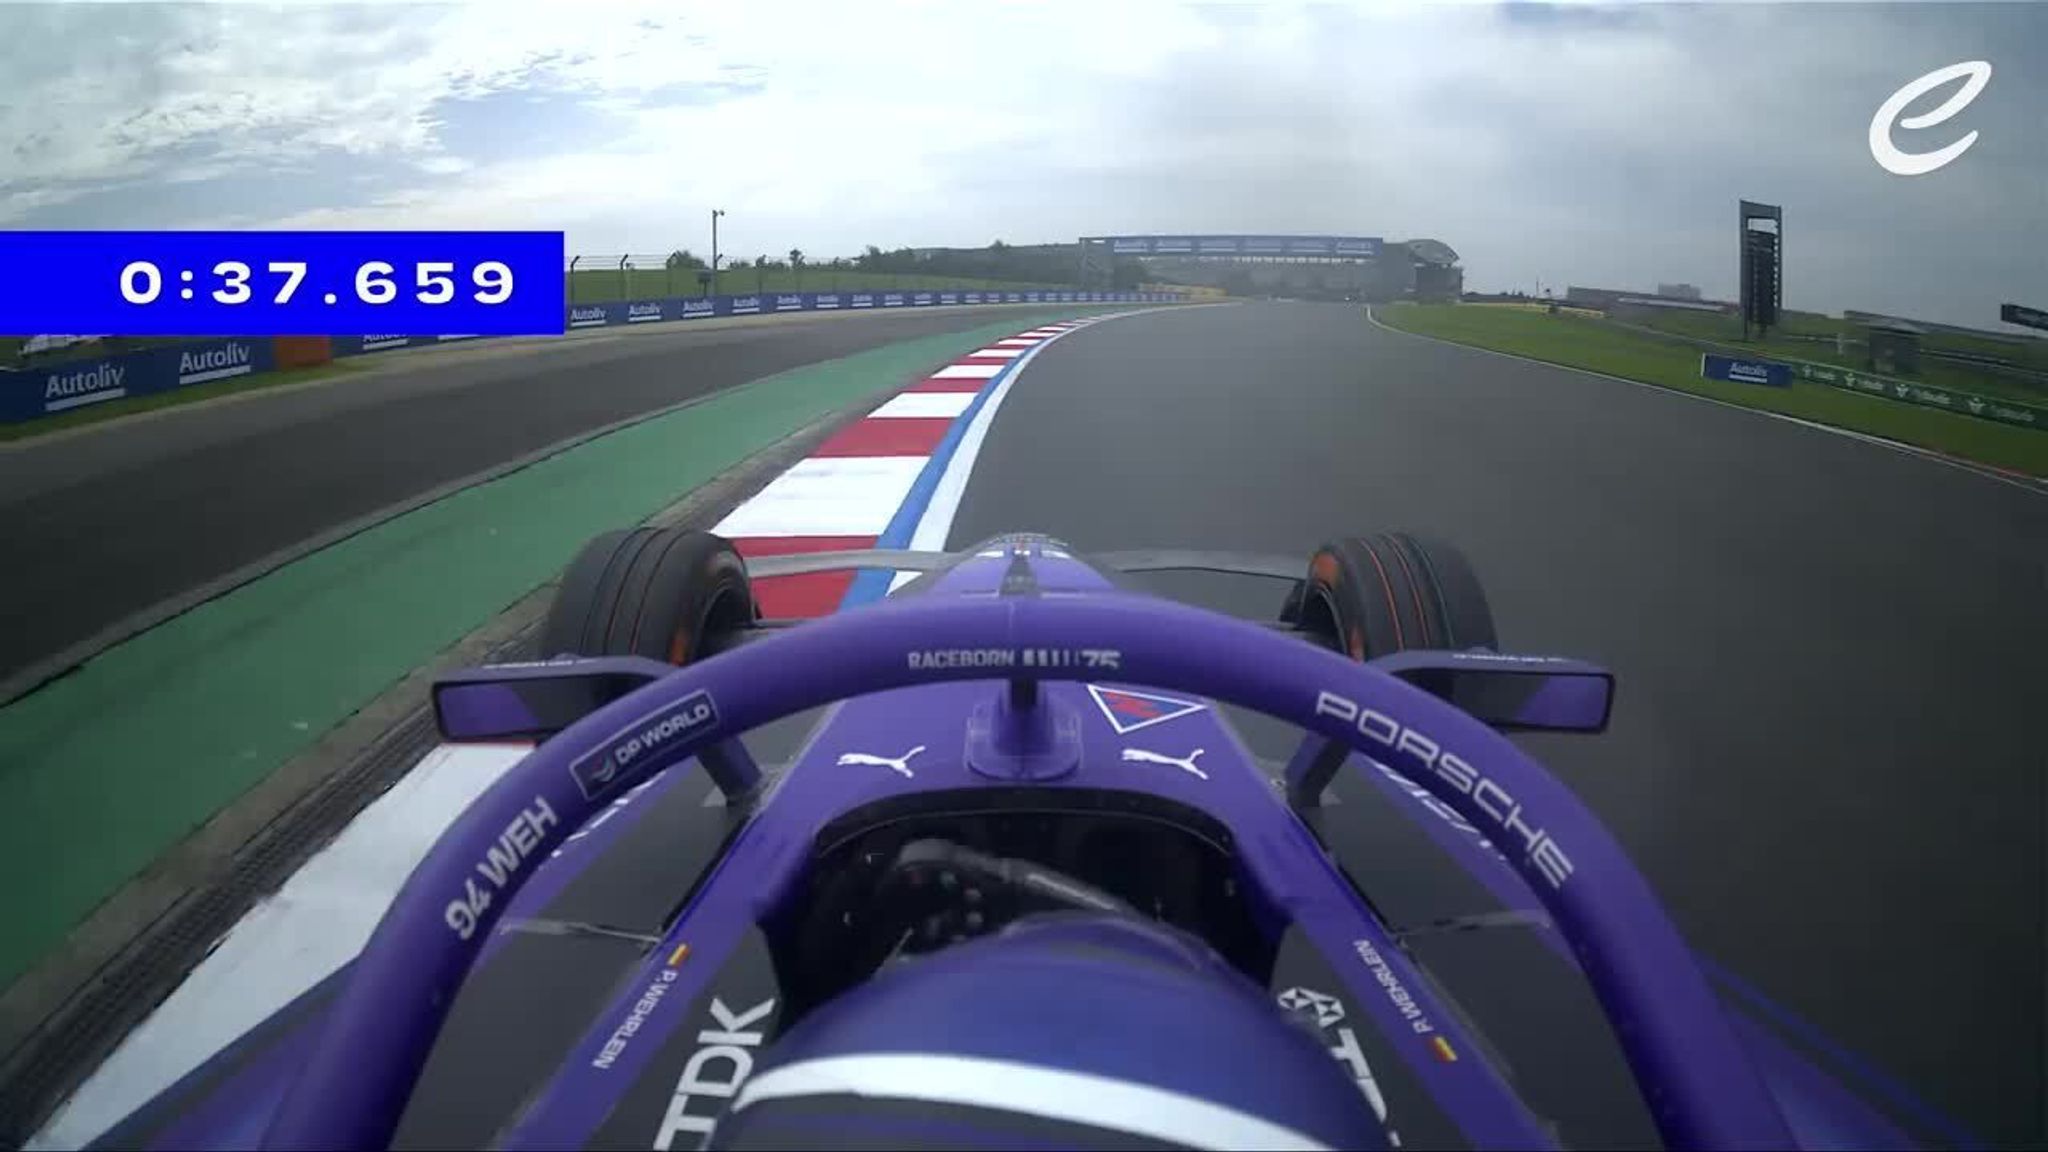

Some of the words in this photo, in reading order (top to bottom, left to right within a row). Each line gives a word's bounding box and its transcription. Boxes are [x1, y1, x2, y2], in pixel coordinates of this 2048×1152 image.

[571, 306, 606, 321] Autoliv
[628, 302, 660, 316] Autoliv
[179, 343, 250, 373] Autoliv
[1729, 362, 1768, 378] Autoliv
[45, 362, 125, 399] Autoliv
[908, 649, 1015, 670] RACEBORN
[614, 739, 641, 764] DP
[640, 703, 710, 748] WORLD
[1316, 691, 1574, 888] PORSCHE
[445, 877, 492, 940] 94
[476, 795, 558, 888] WEH
[653, 998, 775, 1150] TDK
